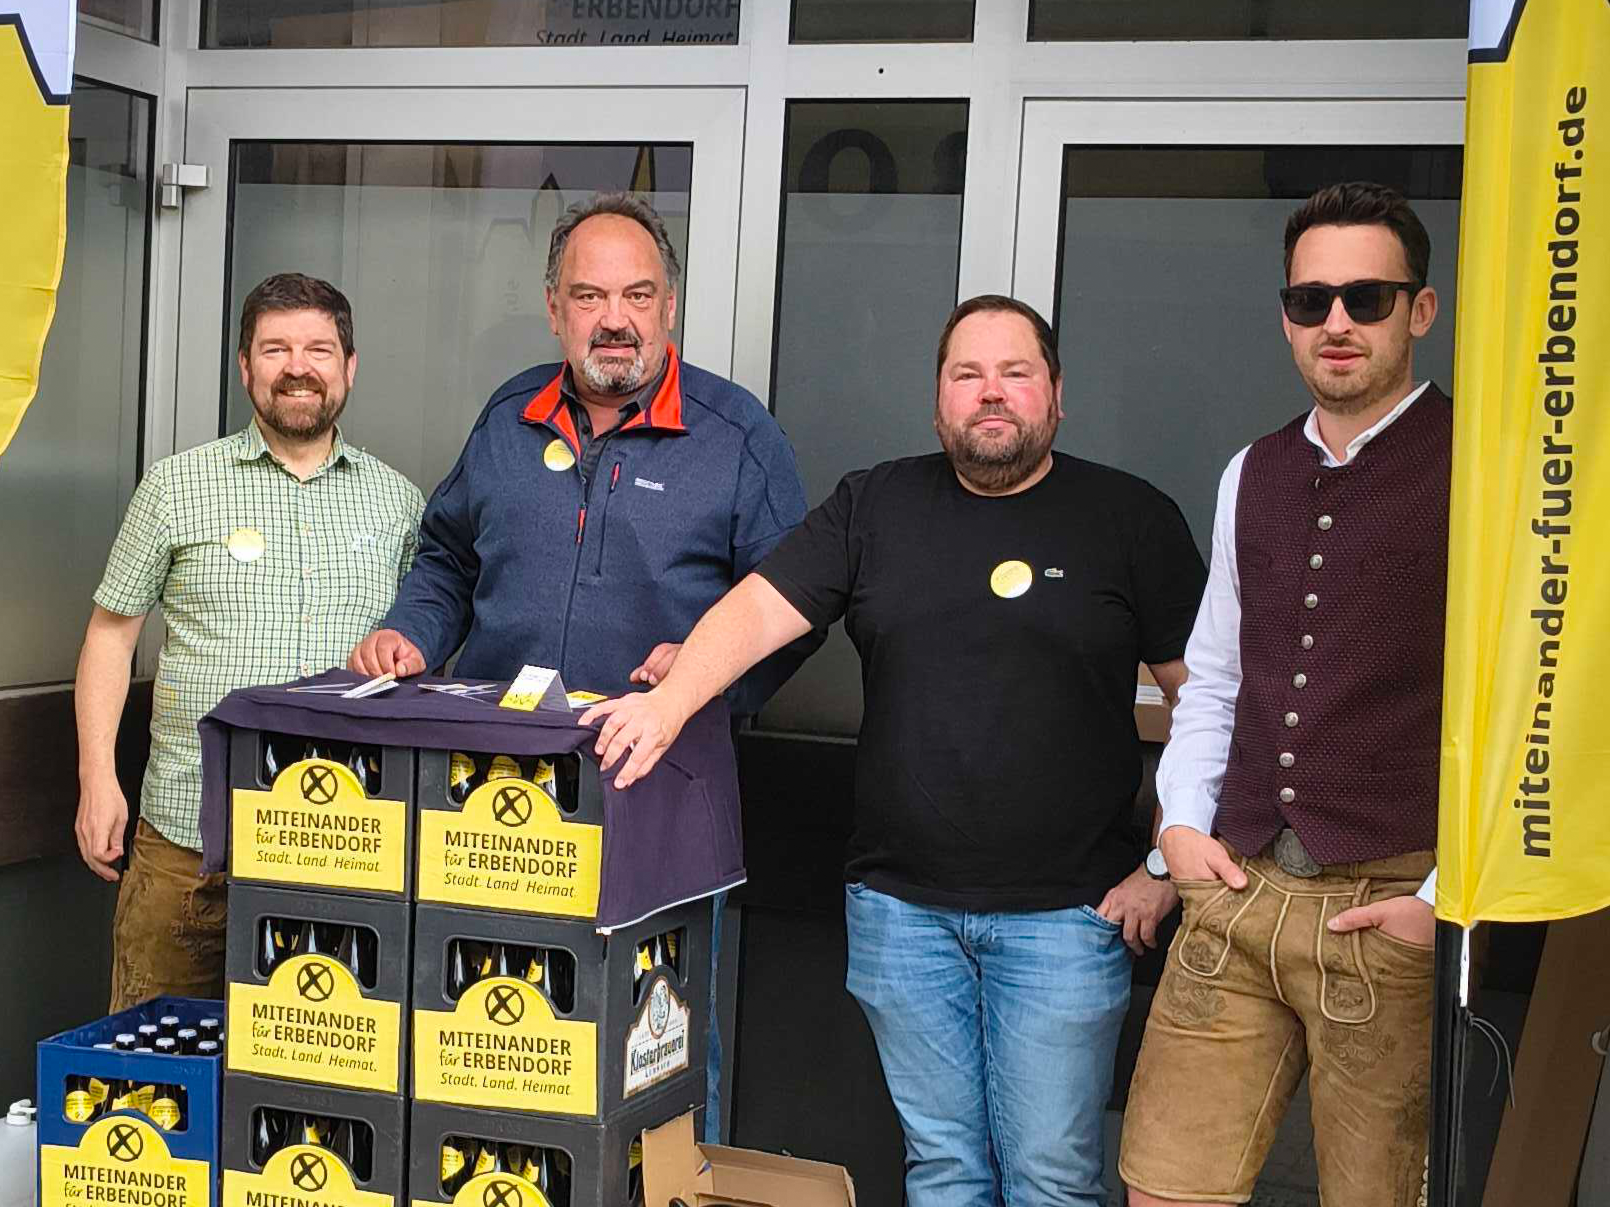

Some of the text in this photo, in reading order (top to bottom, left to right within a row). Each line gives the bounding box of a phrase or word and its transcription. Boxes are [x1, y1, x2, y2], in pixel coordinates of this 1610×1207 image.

[1514, 86, 1587, 857] miteinander-fuer-erbendorf.de
[256, 808, 382, 834] MITEINANDER
[256, 827, 382, 854] für ERBENDORF
[445, 830, 577, 858] MITEINANDER
[444, 849, 578, 878] für ERBENDORF
[252, 1003, 376, 1034] MITEINANDER
[252, 1021, 377, 1053] für ERBENDORF
[439, 1031, 571, 1056] MITEINANDER
[439, 1049, 572, 1076] für ERBENDORF
[64, 1164, 187, 1191] MITEINANDER
[64, 1181, 187, 1207] für ERBENDORF
